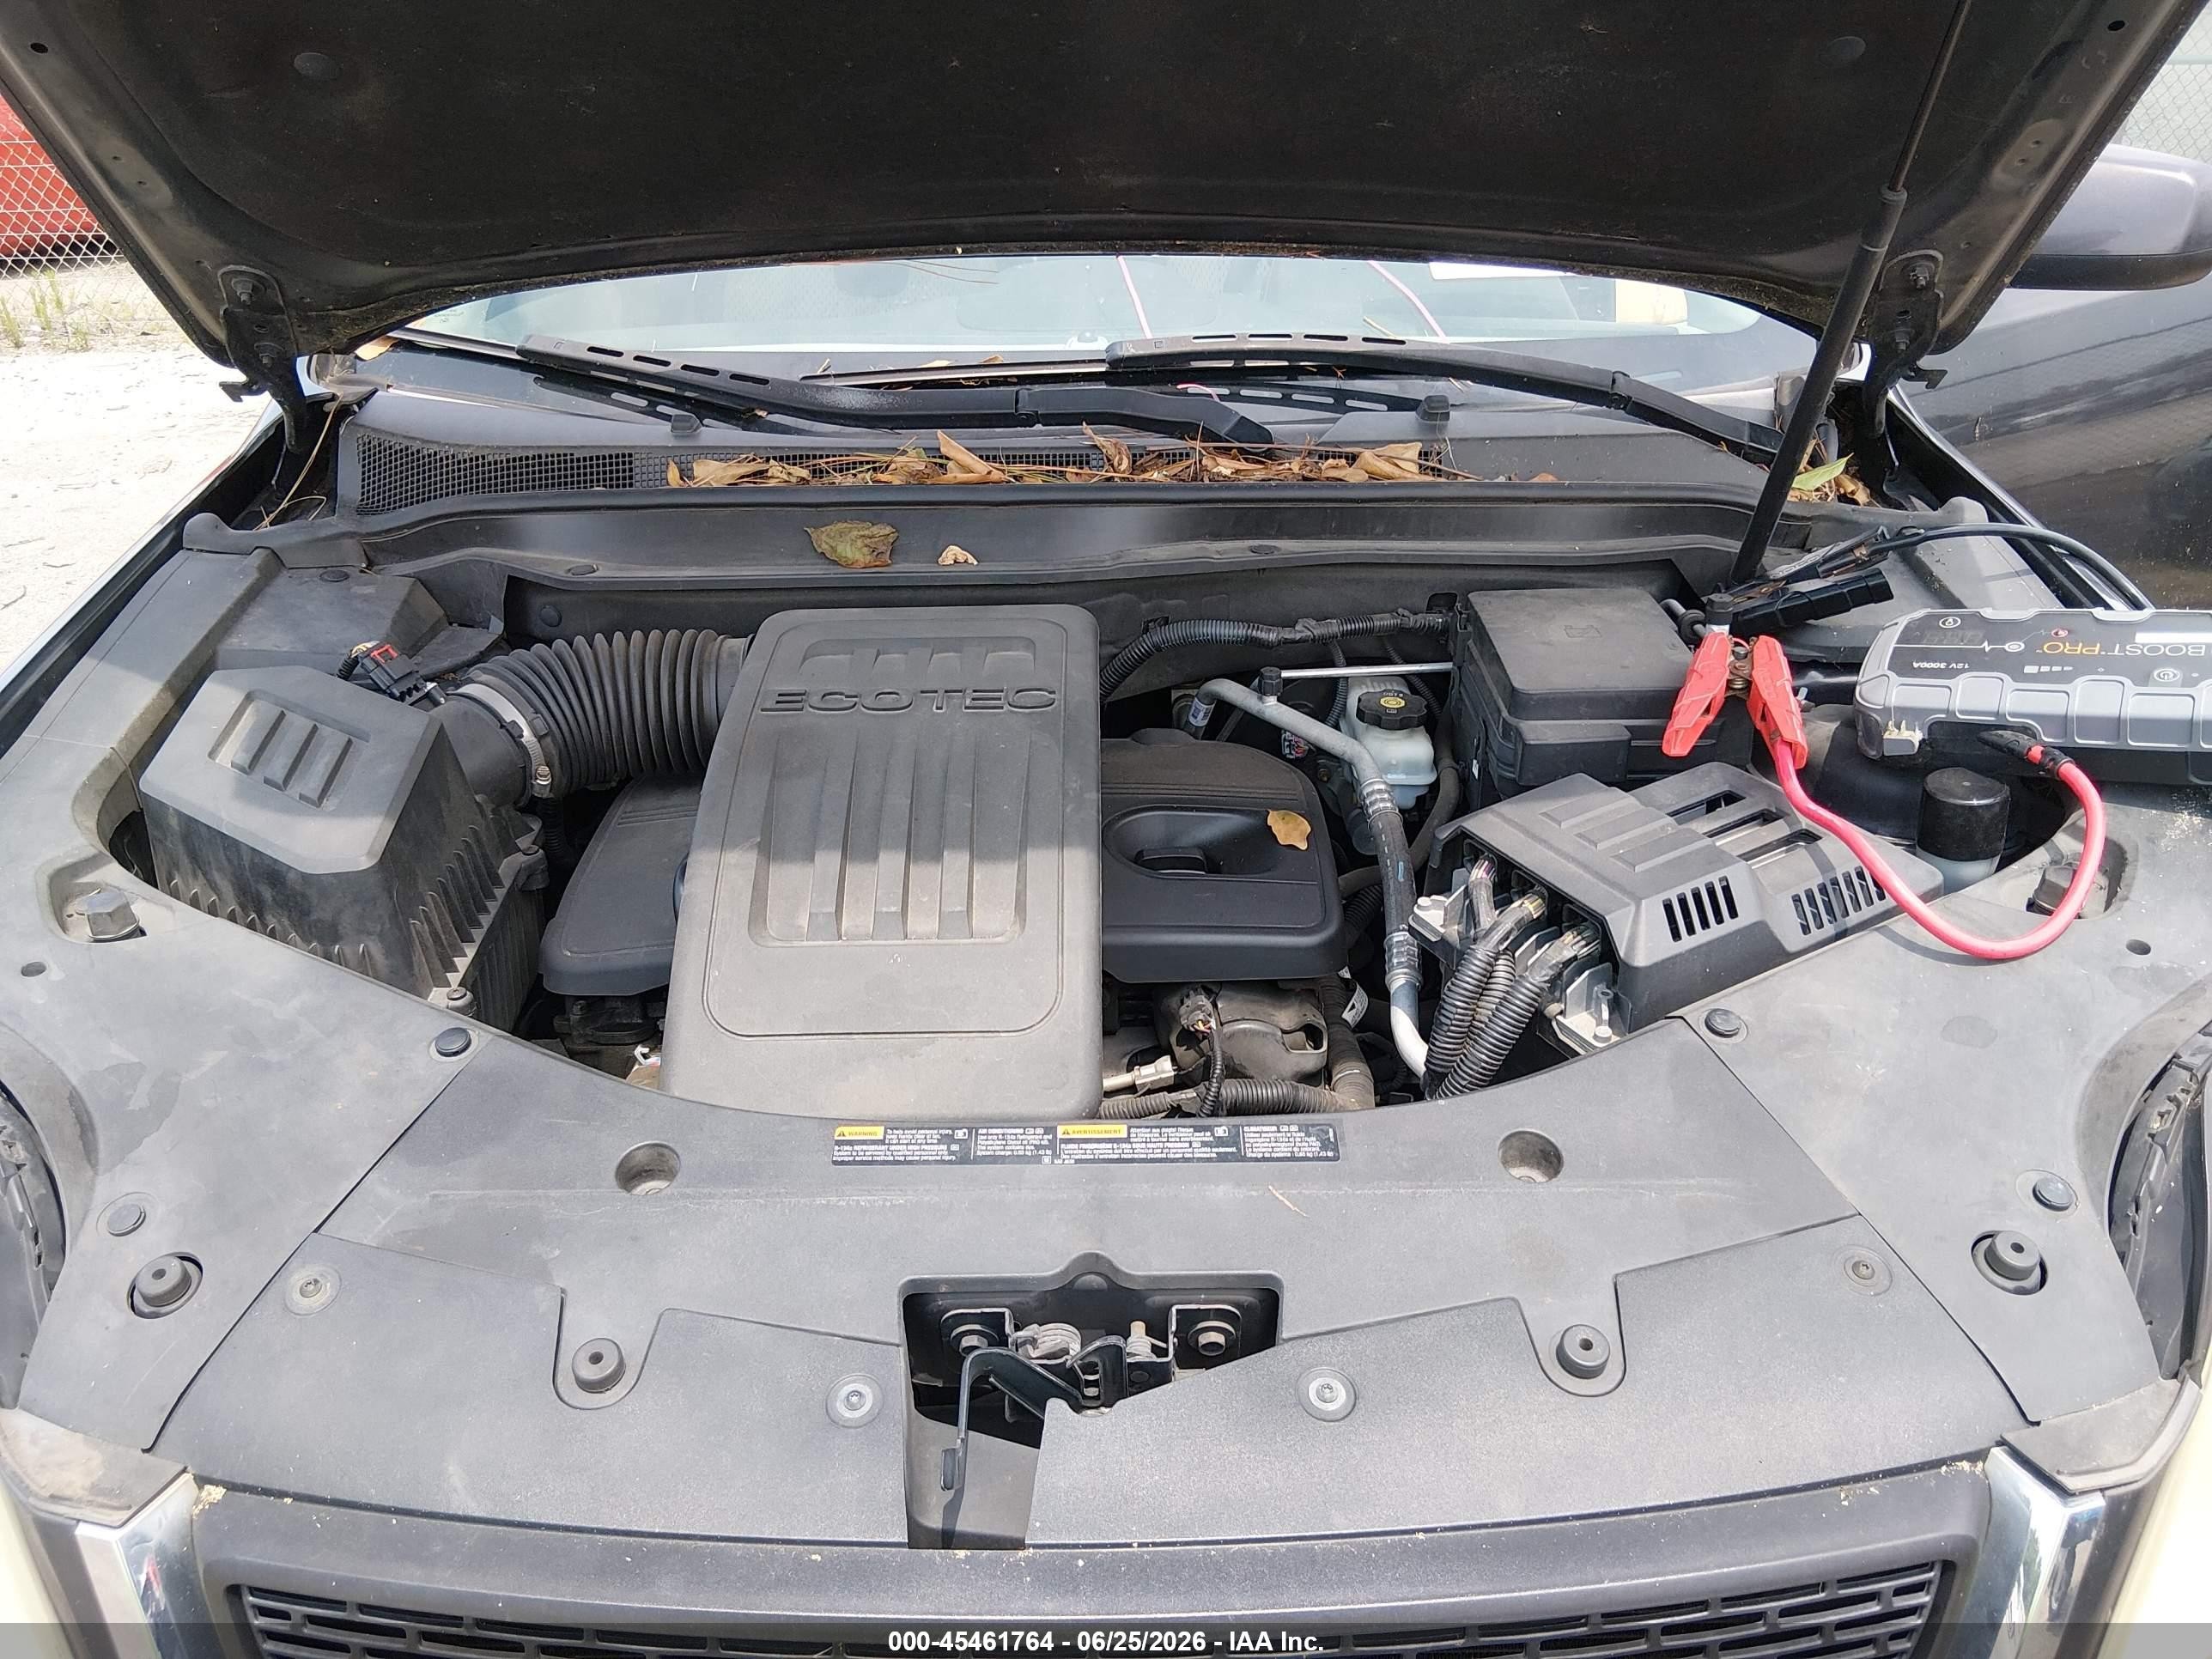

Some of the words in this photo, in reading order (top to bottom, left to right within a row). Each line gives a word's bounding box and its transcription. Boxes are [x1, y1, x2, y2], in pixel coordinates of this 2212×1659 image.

[2042, 641, 2102, 655] PRO
[2106, 642, 2207, 657] BOOST
[1911, 661, 1947, 670] 3000A
[759, 687, 1058, 714] ECOTEC
